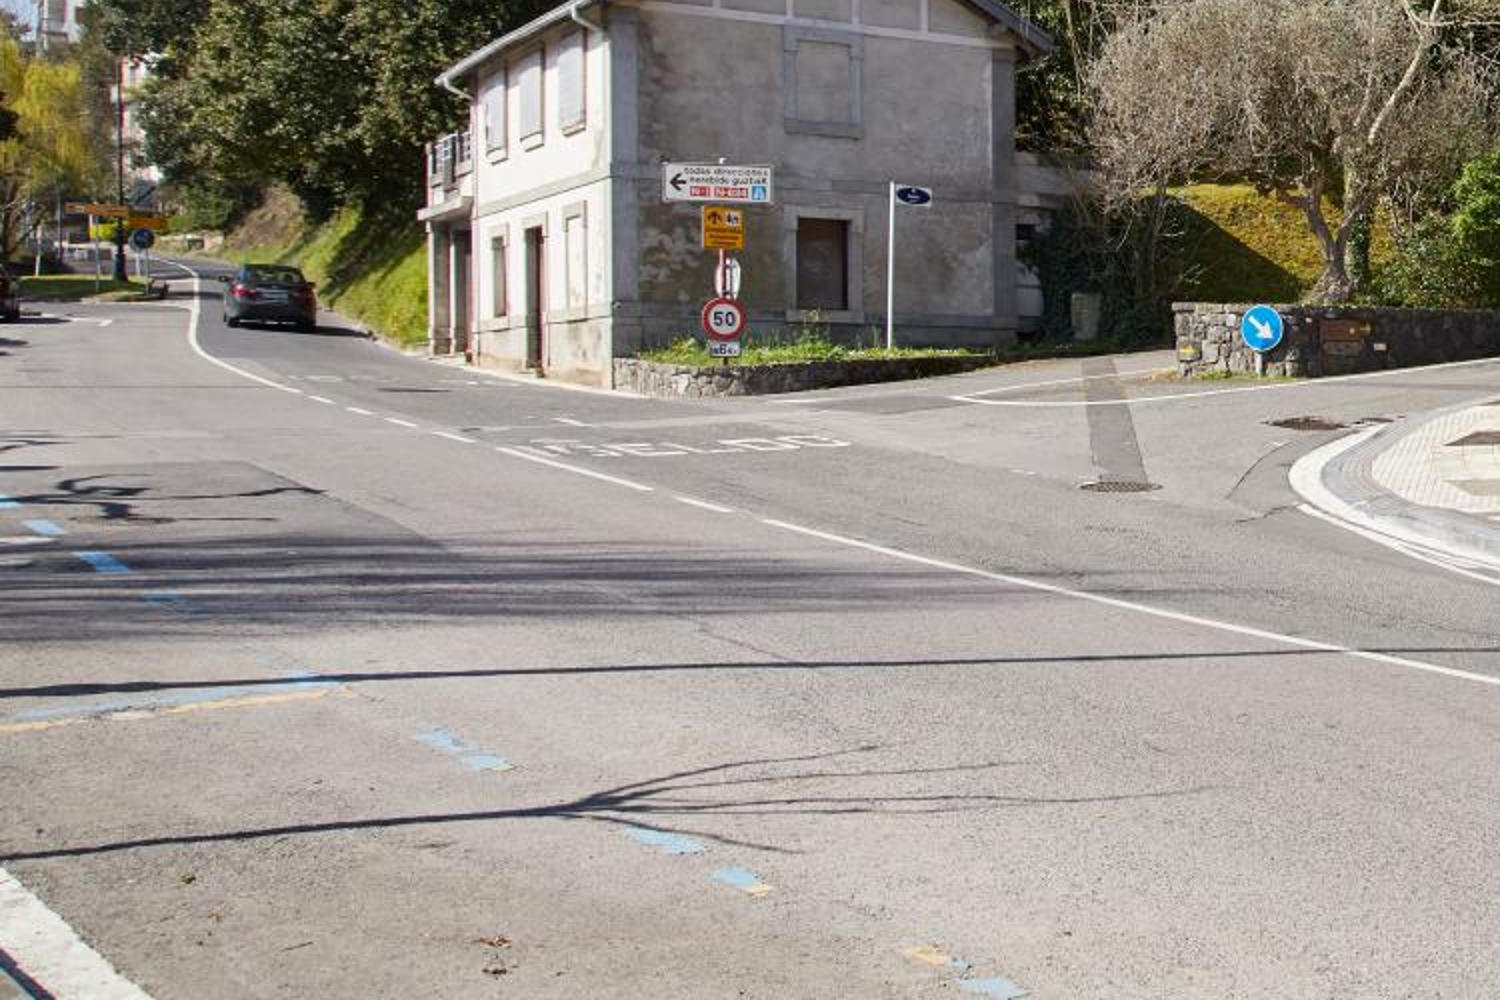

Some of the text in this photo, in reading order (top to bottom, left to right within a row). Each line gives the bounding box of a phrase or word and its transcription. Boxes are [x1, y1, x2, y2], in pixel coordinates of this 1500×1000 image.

[683, 166, 769, 177] todas direcciones
[713, 311, 736, 327] 50
